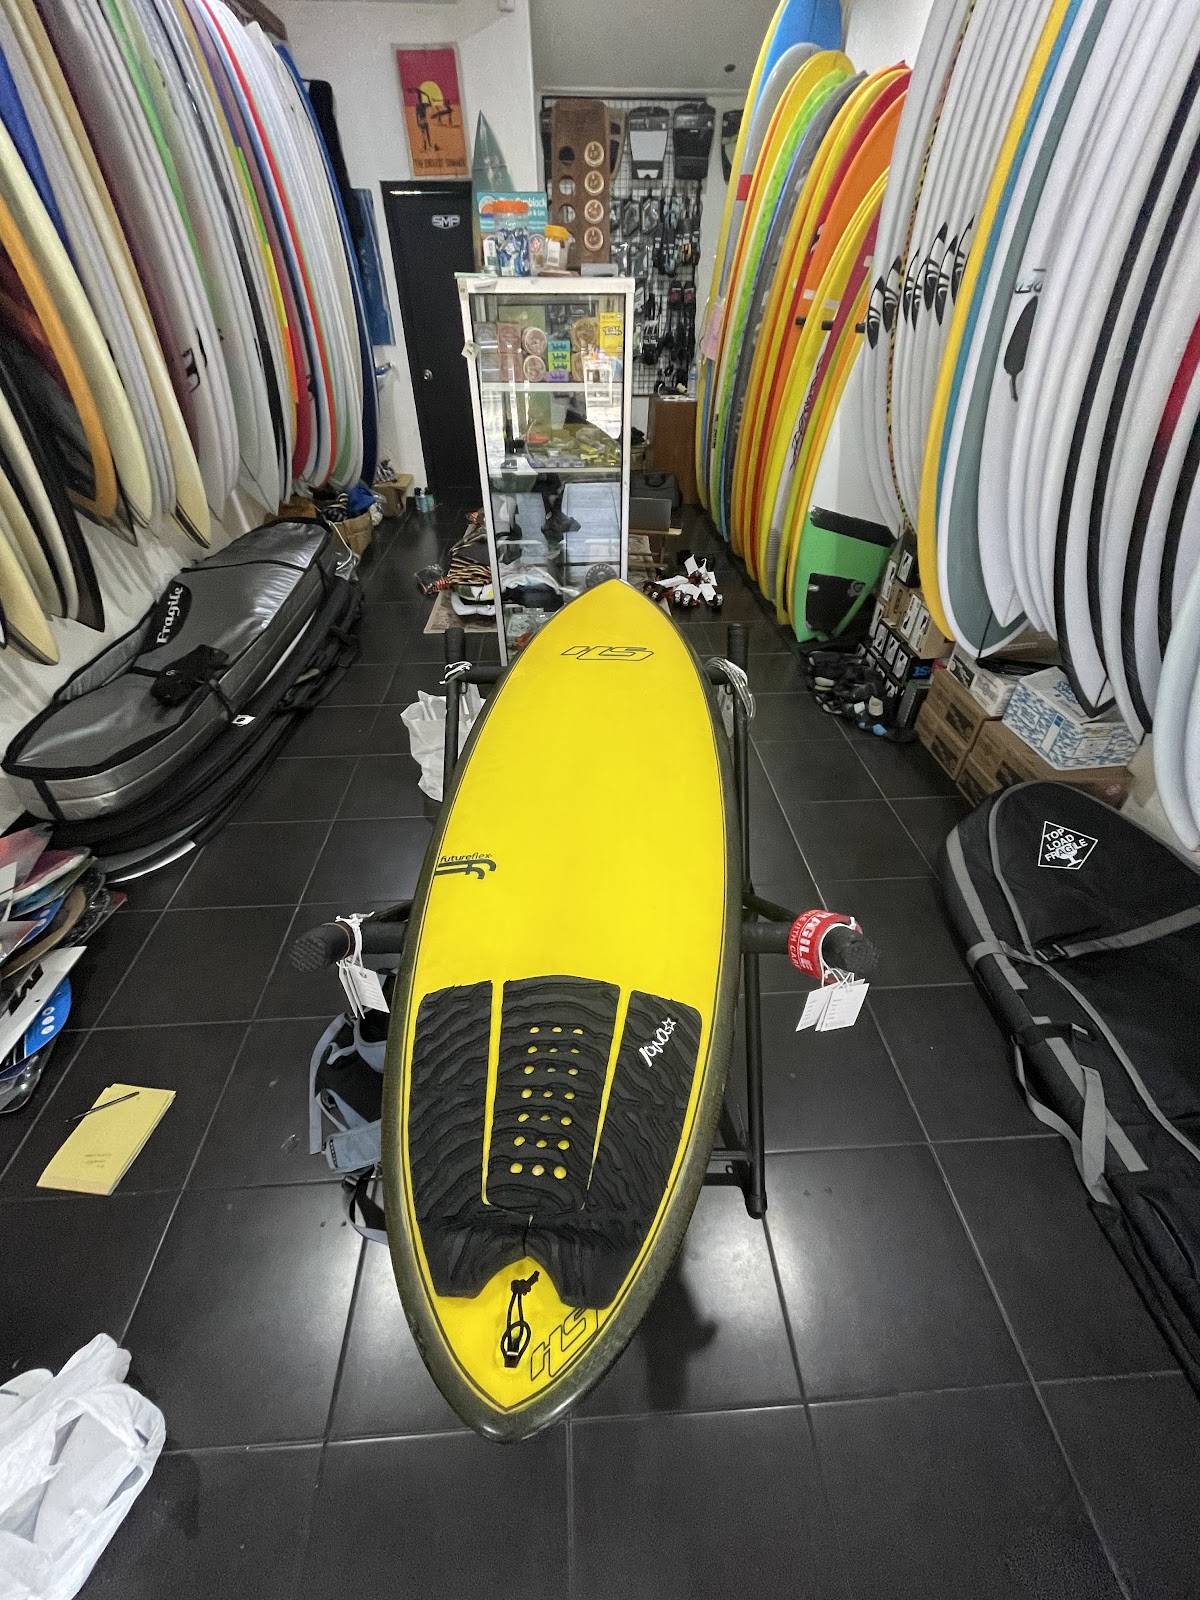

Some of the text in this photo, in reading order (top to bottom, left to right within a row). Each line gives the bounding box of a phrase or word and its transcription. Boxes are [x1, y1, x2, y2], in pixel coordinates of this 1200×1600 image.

[432, 215, 460, 230] SMP
[156, 587, 184, 643] Fragile
[1044, 828, 1065, 842] TOP
[1046, 834, 1075, 851] LOAD
[1044, 838, 1089, 862] FRAGILE
[800, 912, 834, 970] RAGILE
